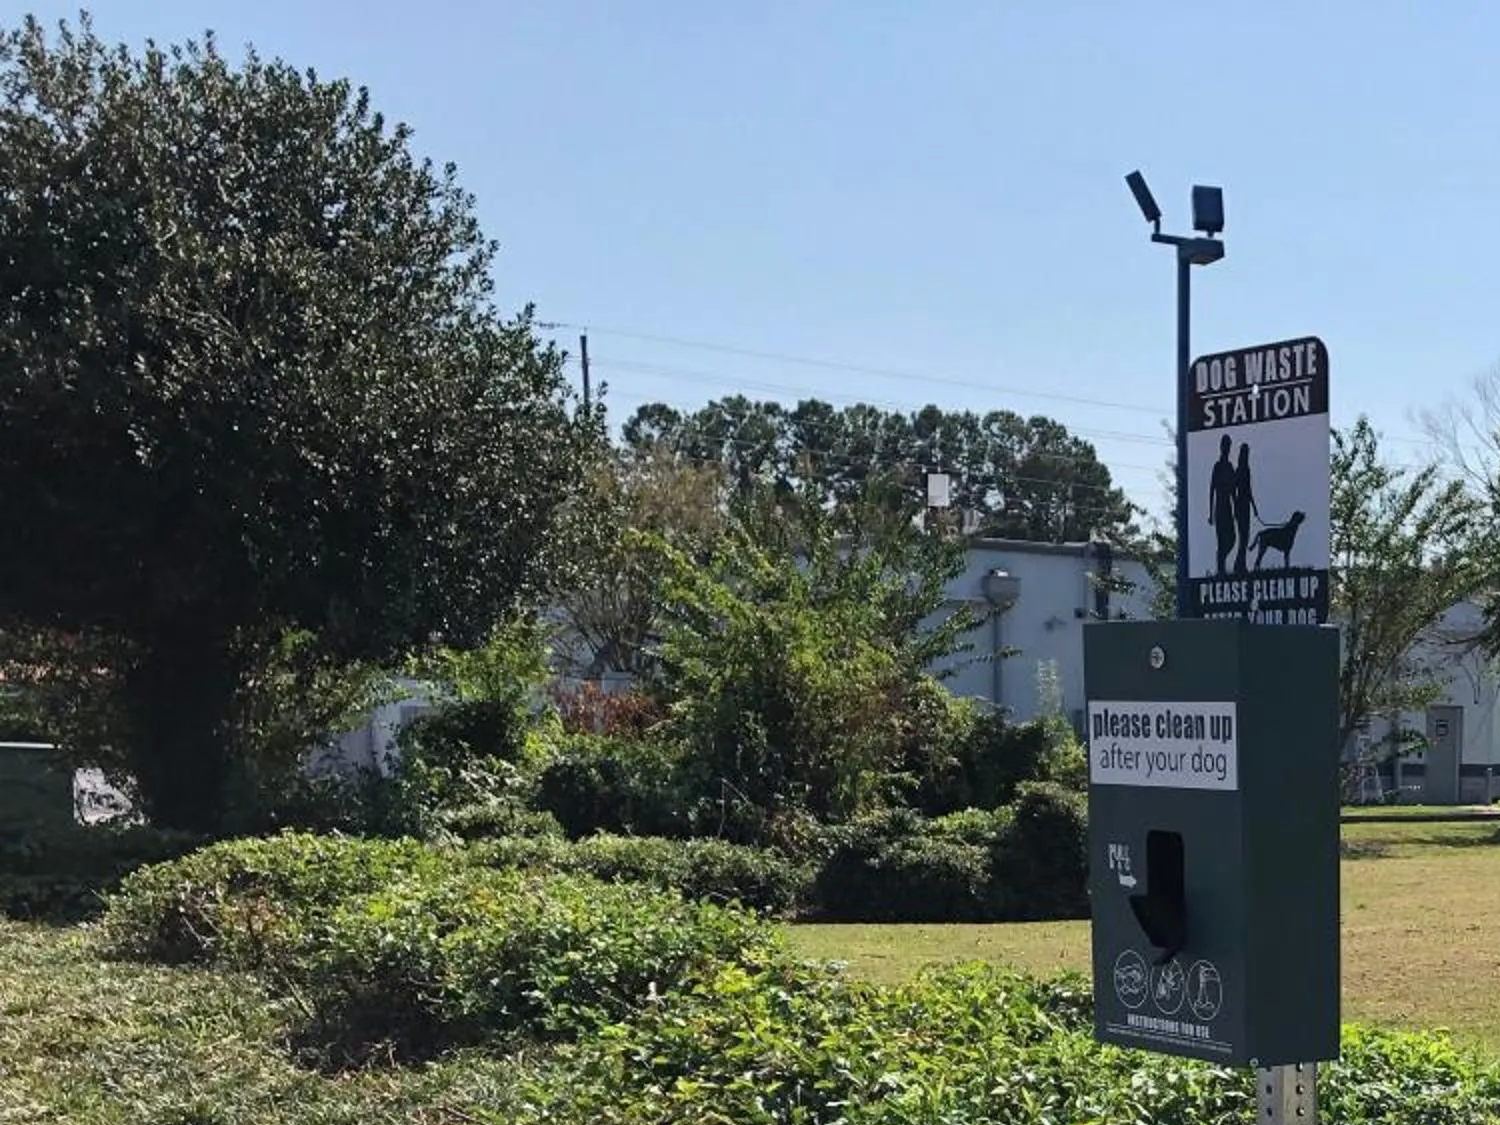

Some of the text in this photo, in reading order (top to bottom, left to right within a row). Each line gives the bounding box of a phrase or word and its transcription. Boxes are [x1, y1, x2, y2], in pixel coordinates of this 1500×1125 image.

[1195, 343, 1317, 393] DOG WASTE
[1203, 385, 1310, 427] STATION
[1200, 575, 1319, 605] PLEASE CLEAN UP
[1093, 708, 1233, 744] please clean up
[1100, 742, 1228, 781] after your dog
